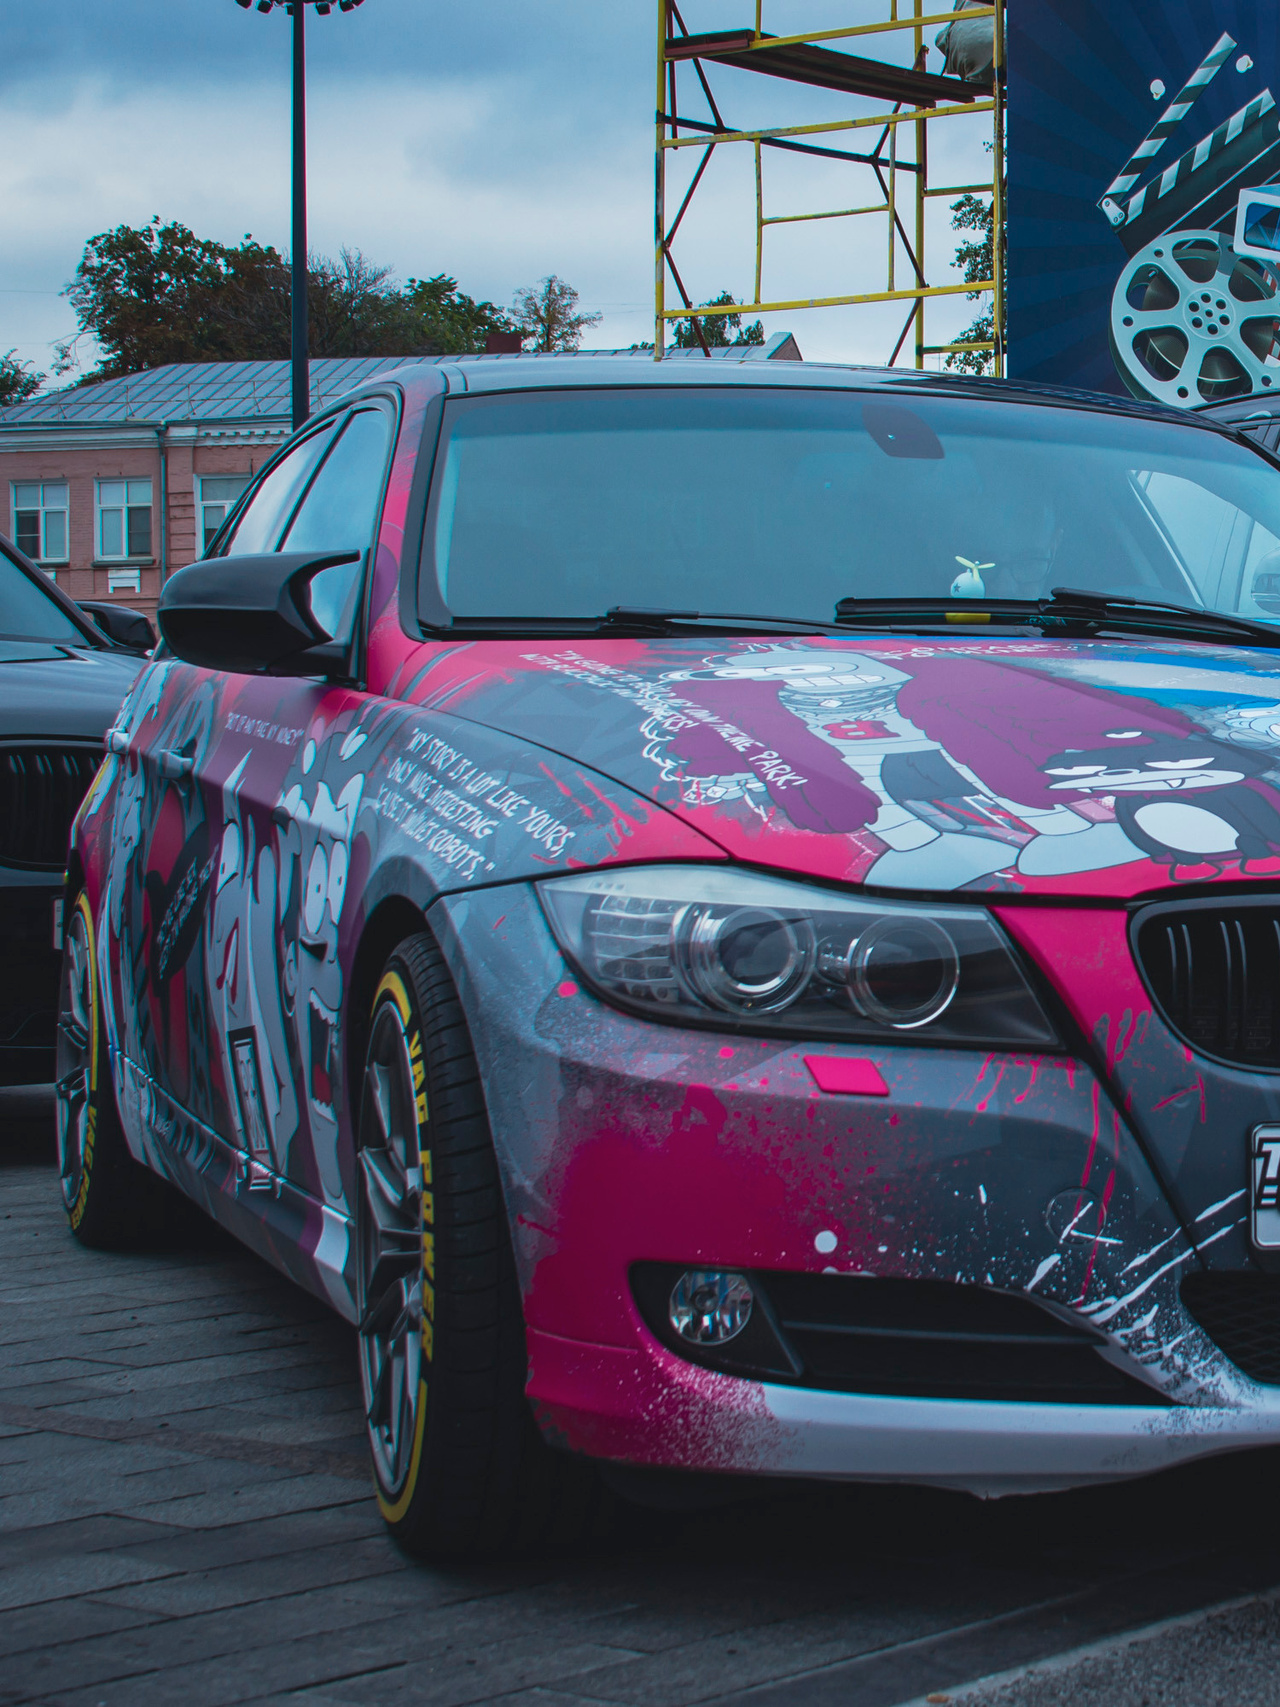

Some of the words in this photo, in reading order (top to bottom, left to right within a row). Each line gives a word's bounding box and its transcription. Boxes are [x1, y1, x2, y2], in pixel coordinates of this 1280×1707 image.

[422, 738, 463, 771] STORY
[448, 758, 473, 780] IS
[748, 750, 809, 790] PARK!
[457, 767, 479, 786] A
[465, 772, 501, 797] LOT
[387, 757, 418, 784] ONLY
[425, 784, 500, 839] INTERESTING
[486, 785, 532, 818] LIKE
[517, 806, 576, 859] YOURS,
